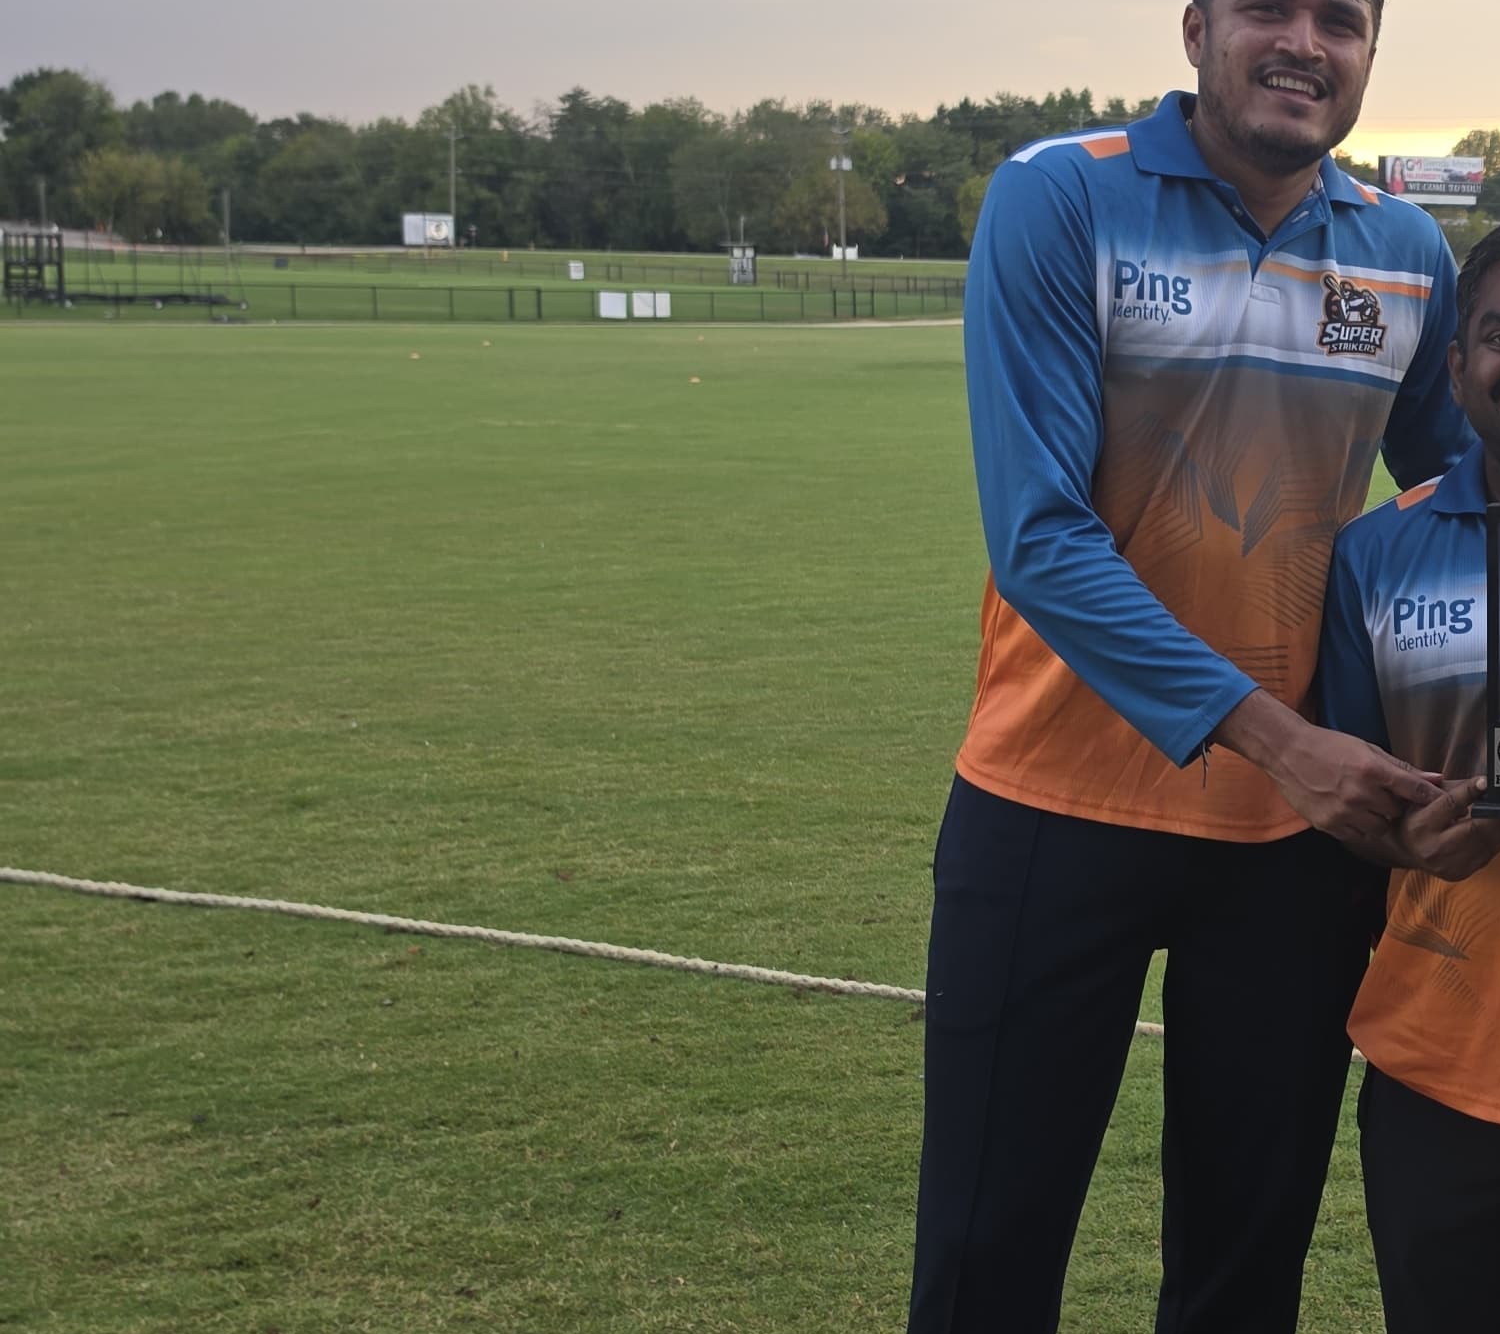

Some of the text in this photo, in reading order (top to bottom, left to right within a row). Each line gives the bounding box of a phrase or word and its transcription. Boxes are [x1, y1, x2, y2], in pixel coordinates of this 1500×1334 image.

[1114, 259, 1192, 315] Ping
[1322, 322, 1384, 346] SUPER
[1330, 342, 1376, 353] STRIKERS
[1393, 595, 1476, 634] Ping
